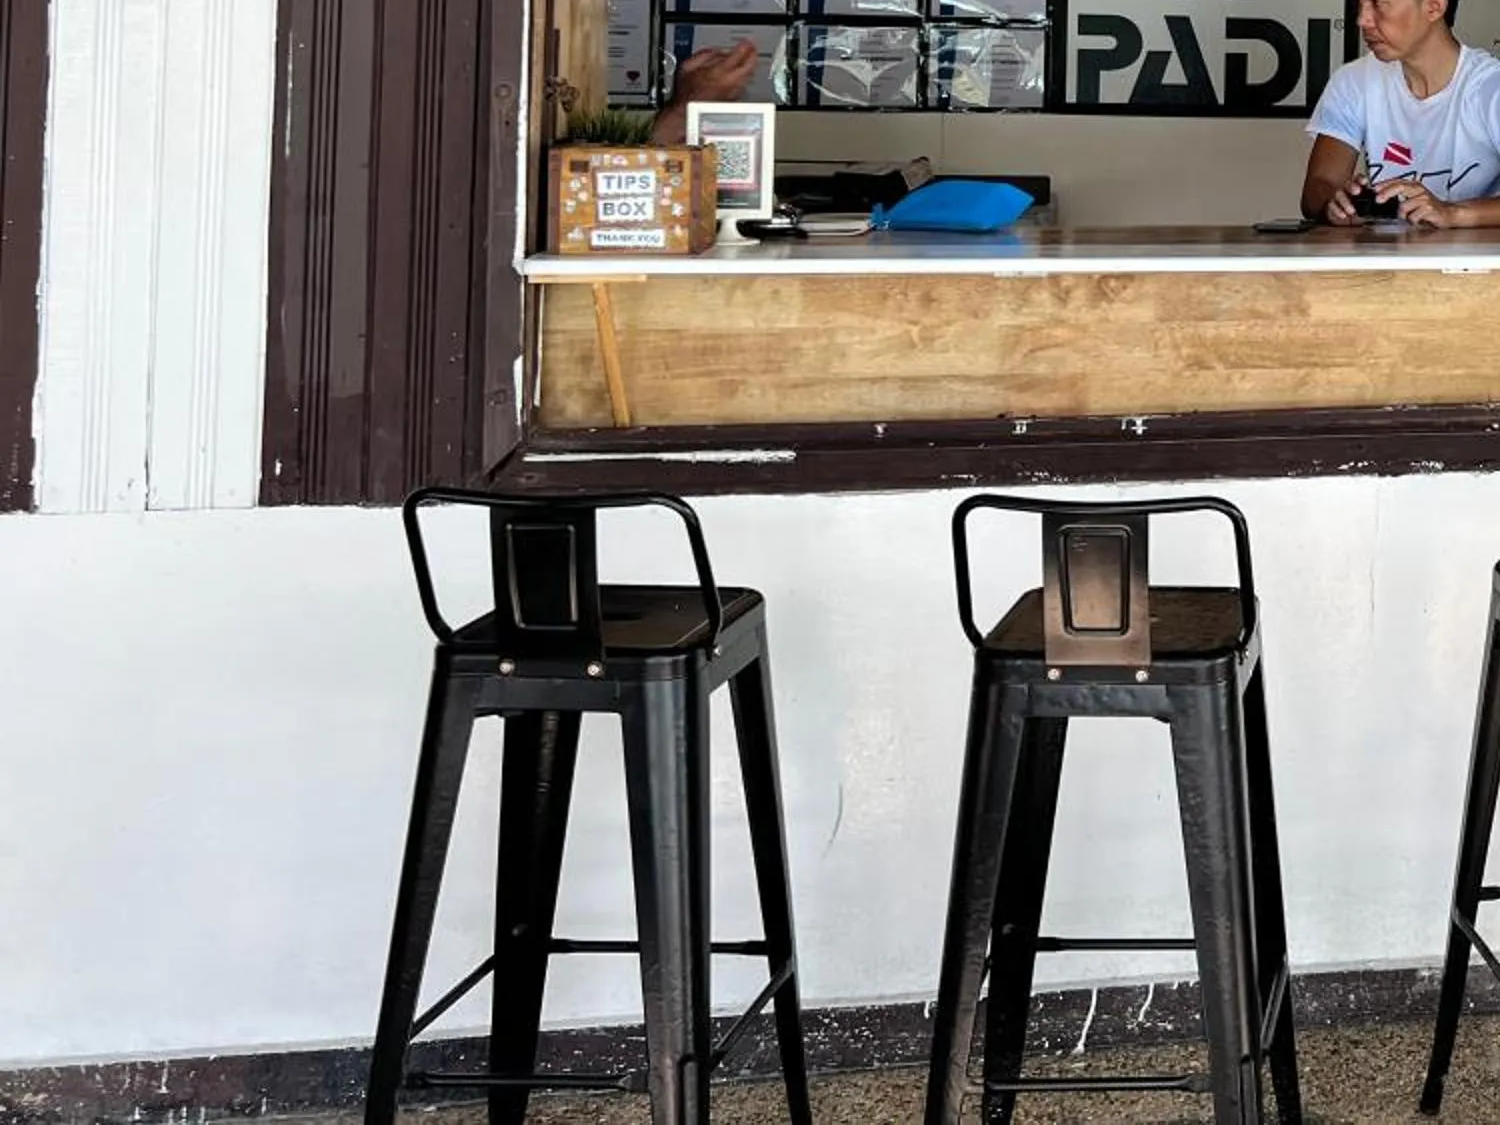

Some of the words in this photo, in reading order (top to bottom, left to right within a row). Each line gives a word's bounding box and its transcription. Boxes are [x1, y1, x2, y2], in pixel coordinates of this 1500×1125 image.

[1075, 13, 1332, 107] PADI
[602, 175, 652, 191] TIPS
[602, 202, 648, 216] BOX
[596, 233, 634, 244] THANK
[637, 233, 661, 244] YOU
